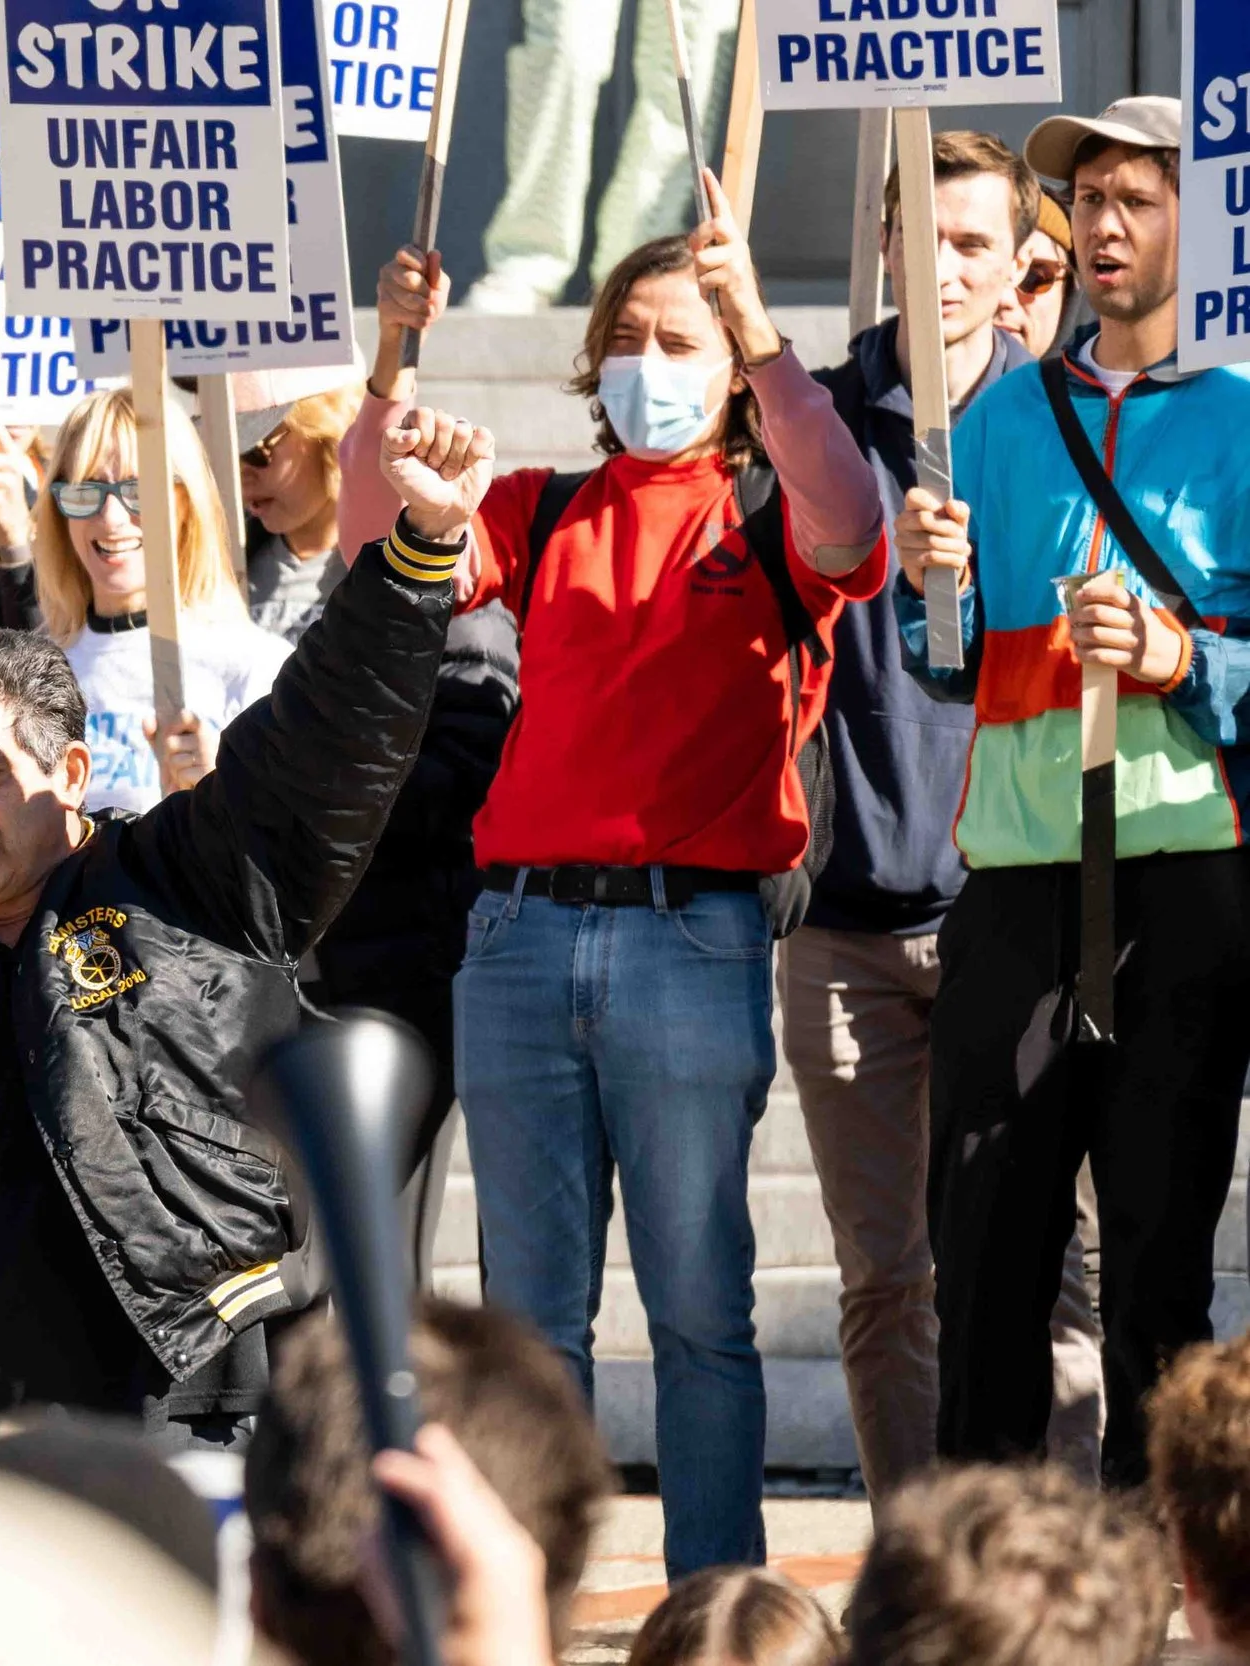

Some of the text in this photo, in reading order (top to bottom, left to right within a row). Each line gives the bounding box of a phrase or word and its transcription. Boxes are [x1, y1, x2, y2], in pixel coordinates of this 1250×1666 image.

[333, 1, 399, 50] OR
[16, 22, 261, 91] STRIKE
[778, 27, 1044, 82] PRACTICE
[47, 117, 238, 169] UNFAIR
[60, 179, 231, 230] LABOR
[22, 240, 277, 292] PRACTICE
[90, 292, 340, 354] PACICE
[71, 970, 147, 1010] LOCAL 2010
